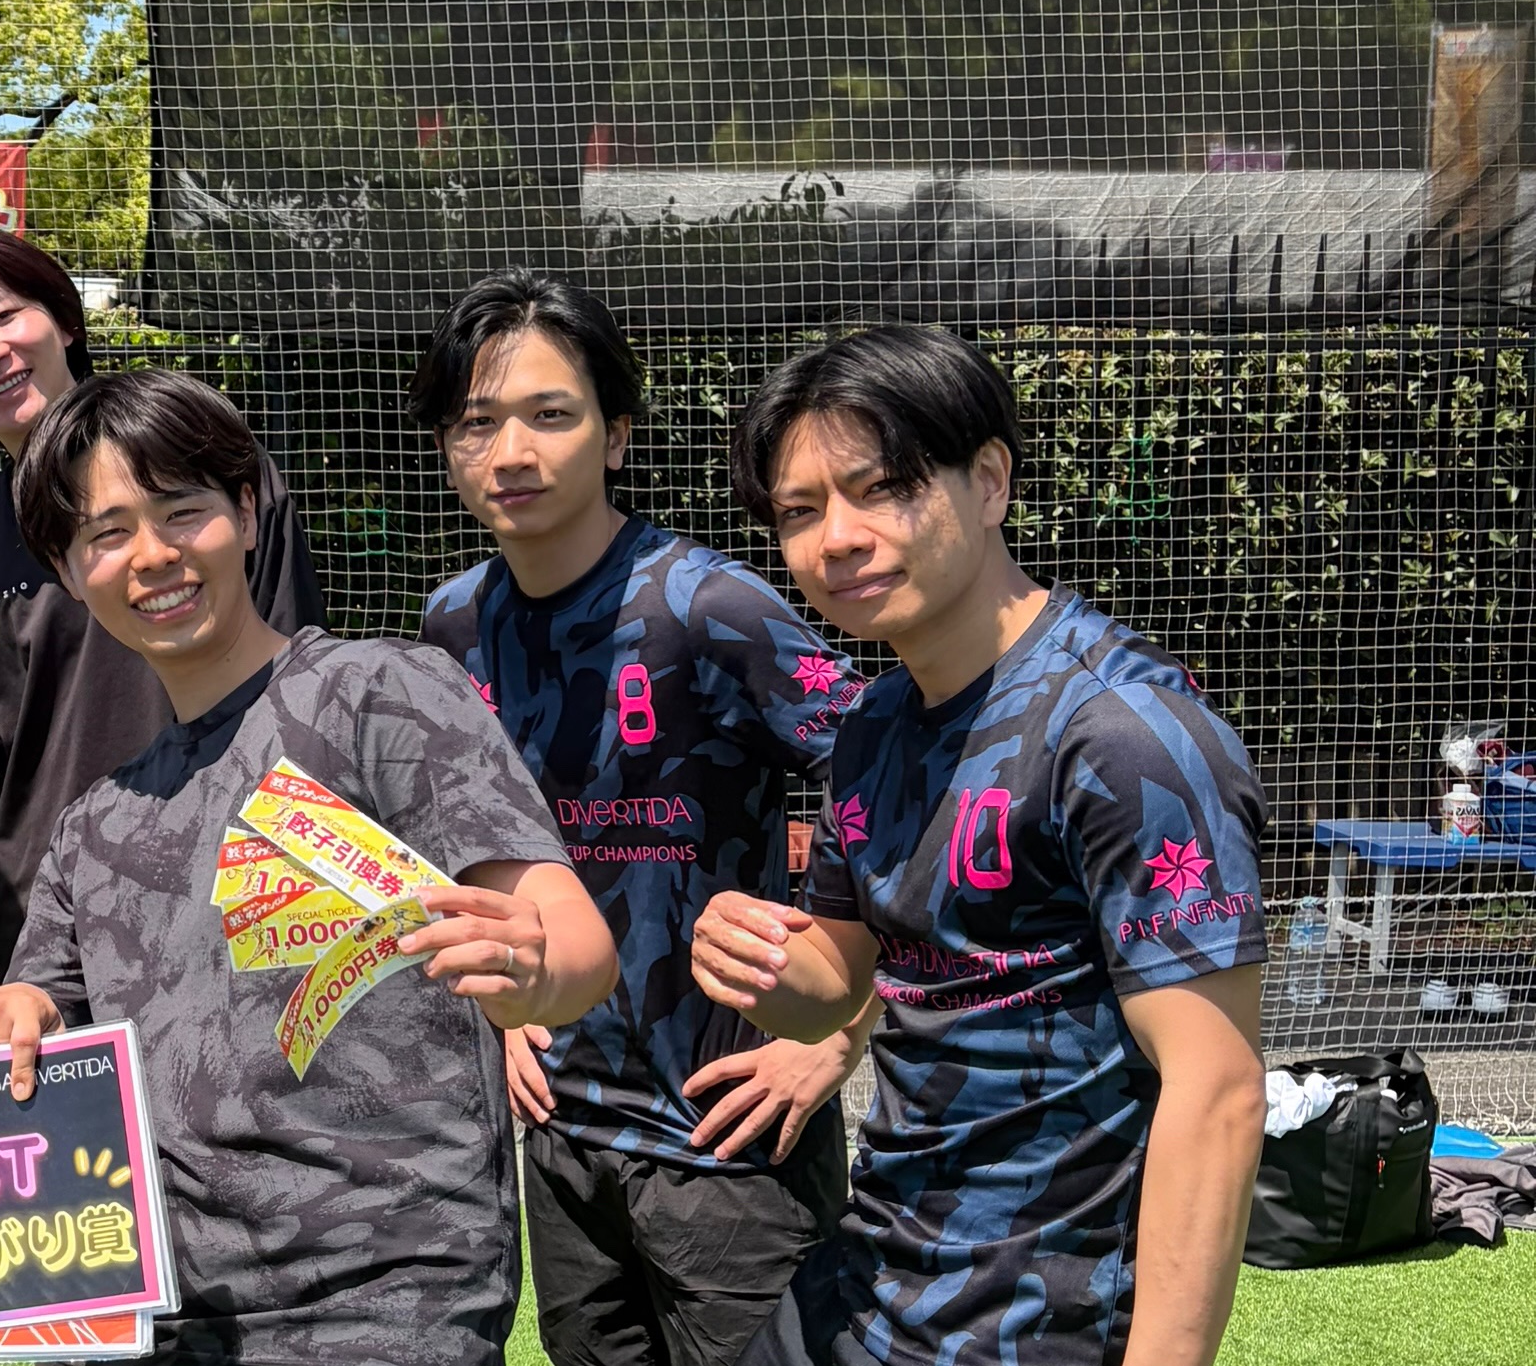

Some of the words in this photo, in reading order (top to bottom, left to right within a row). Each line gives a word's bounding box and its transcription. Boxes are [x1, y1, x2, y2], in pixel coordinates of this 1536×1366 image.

[617, 663, 657, 745] 8
[286, 810, 405, 898] 餃子引換券
[350, 835, 382, 857] TICKET
[564, 844, 592, 861] CUP
[594, 843, 697, 862] CHAMPIONS
[948, 787, 1013, 890] 10
[265, 916, 365, 951] 1,000
[286, 910, 323, 922] SPECIAL
[326, 905, 360, 917] TICKET
[302, 934, 400, 1033] 1,000円券
